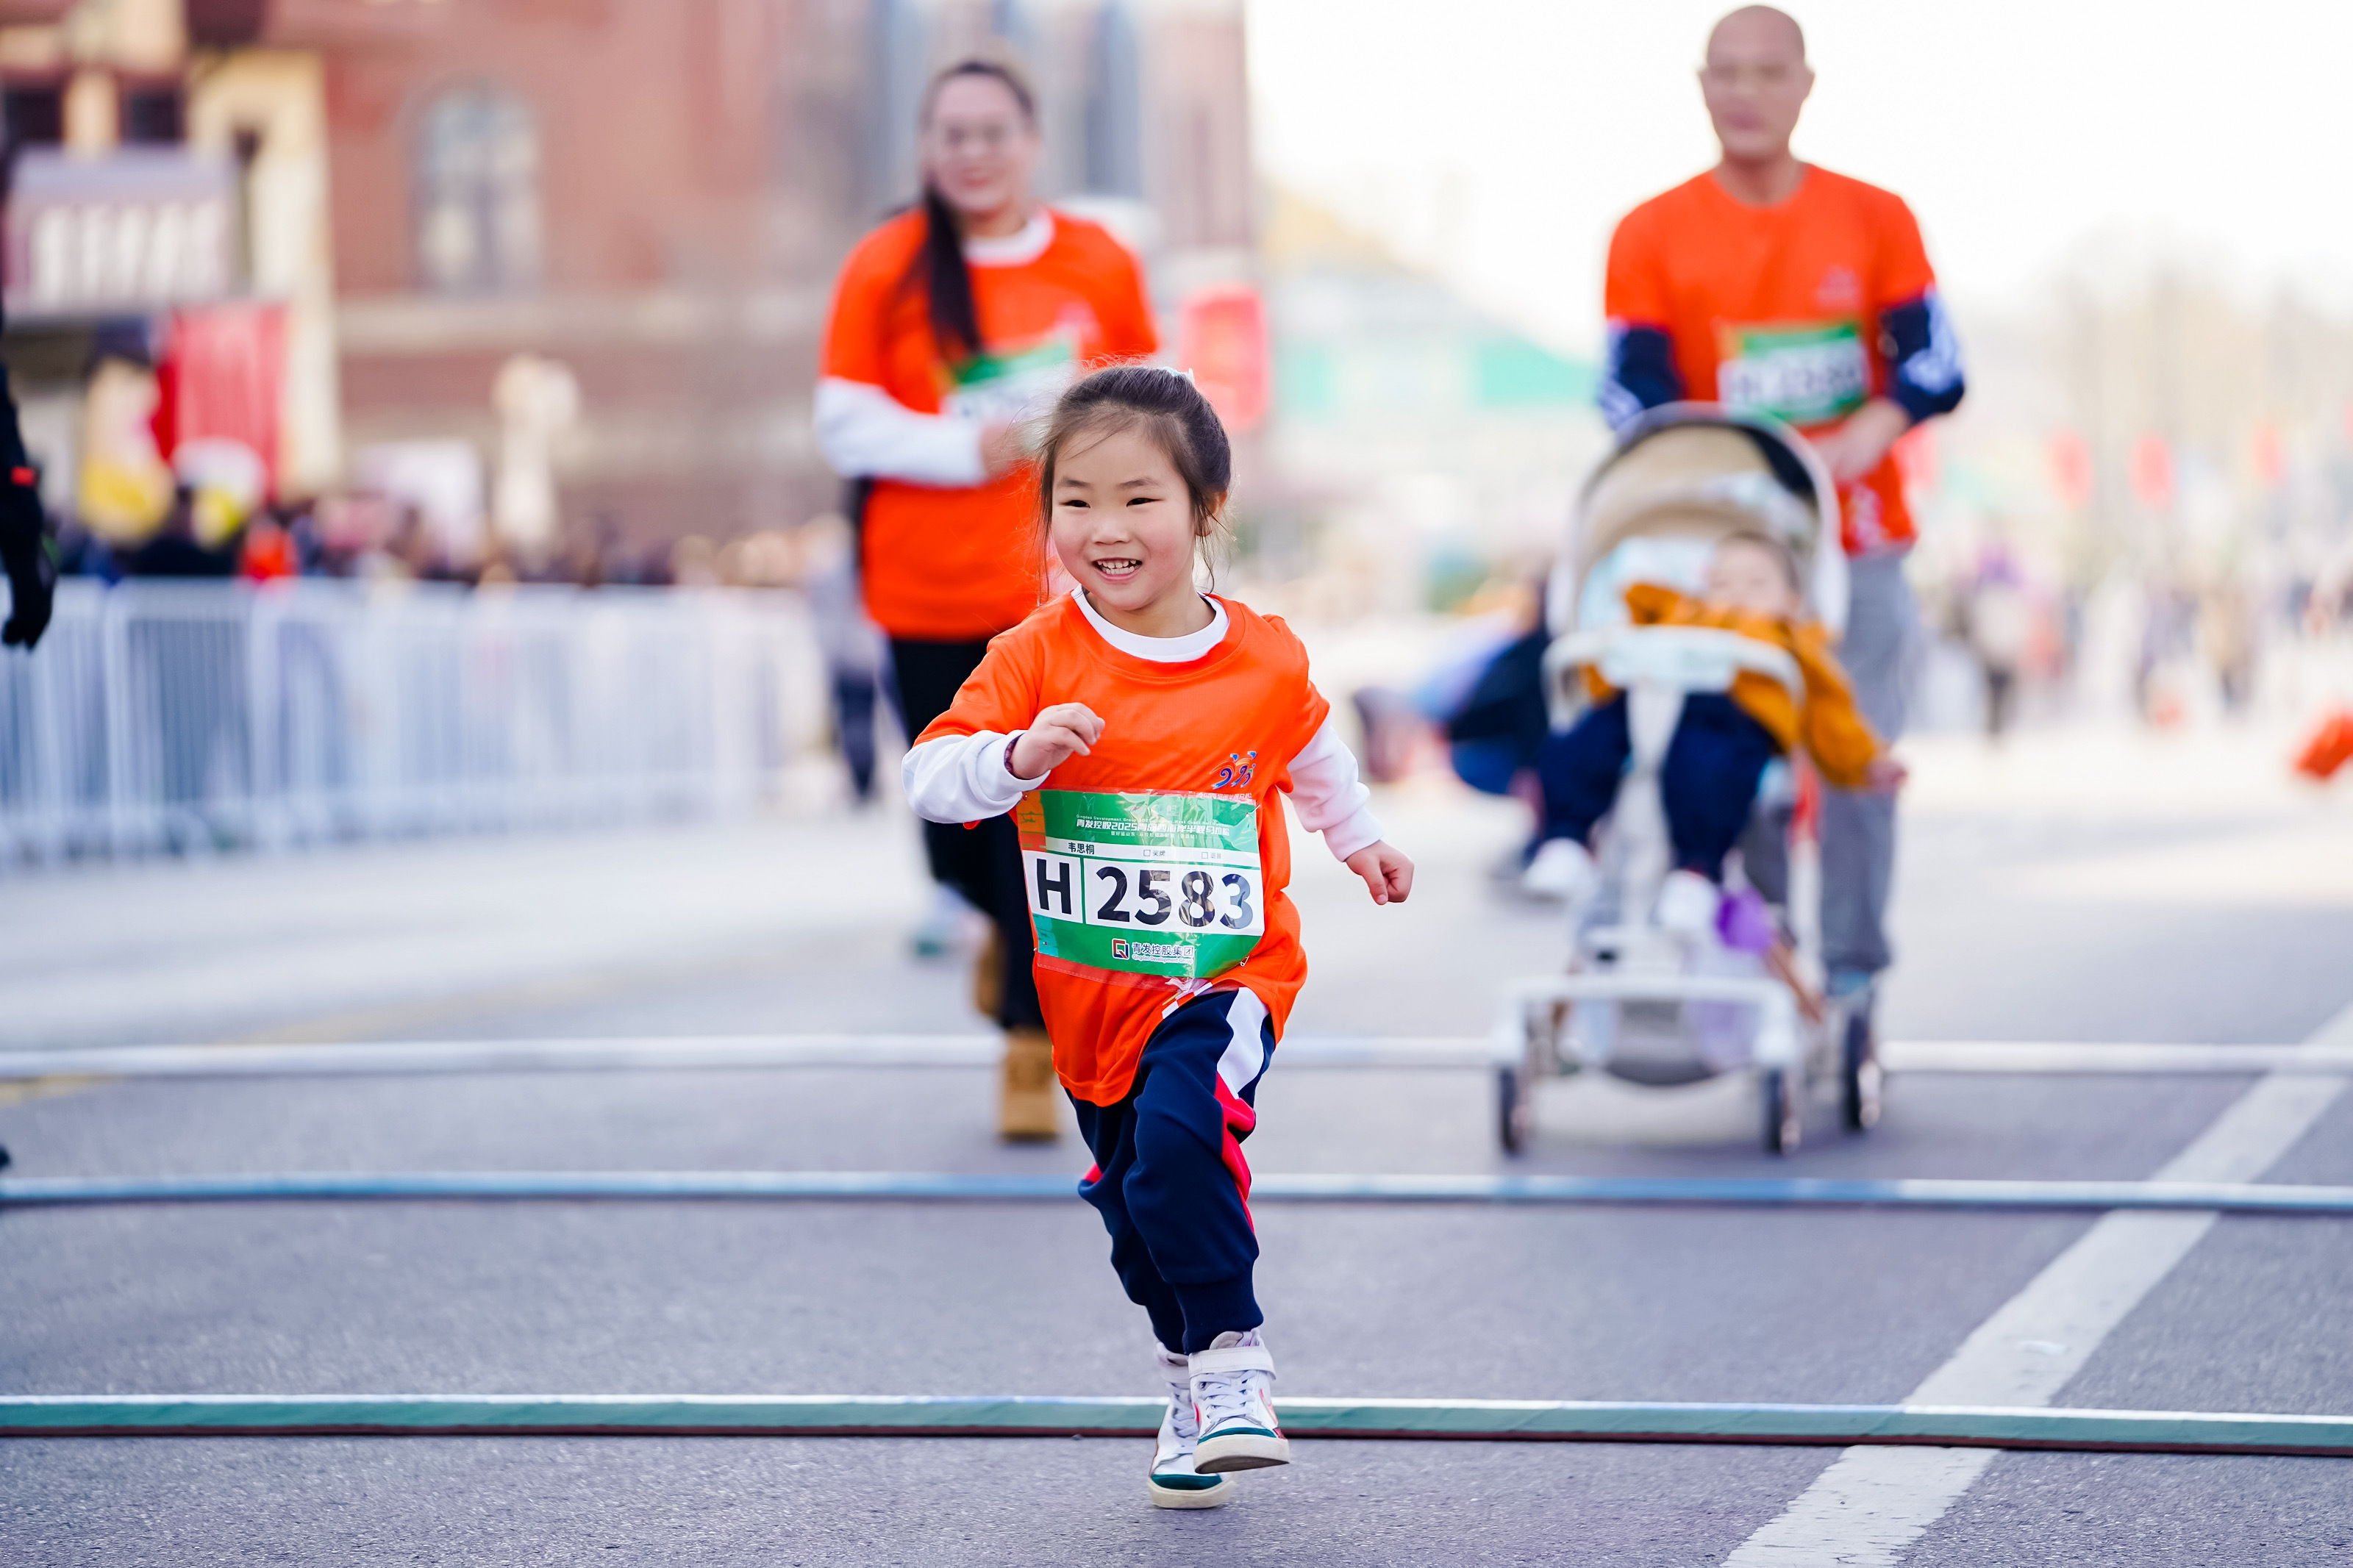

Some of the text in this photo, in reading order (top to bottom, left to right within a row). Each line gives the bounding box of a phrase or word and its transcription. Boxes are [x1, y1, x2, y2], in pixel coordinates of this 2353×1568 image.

[1068, 842, 1095, 855] 韦思桐
[1036, 858, 1254, 930] H 2583
[1132, 942, 1194, 957] 青发控股集团
